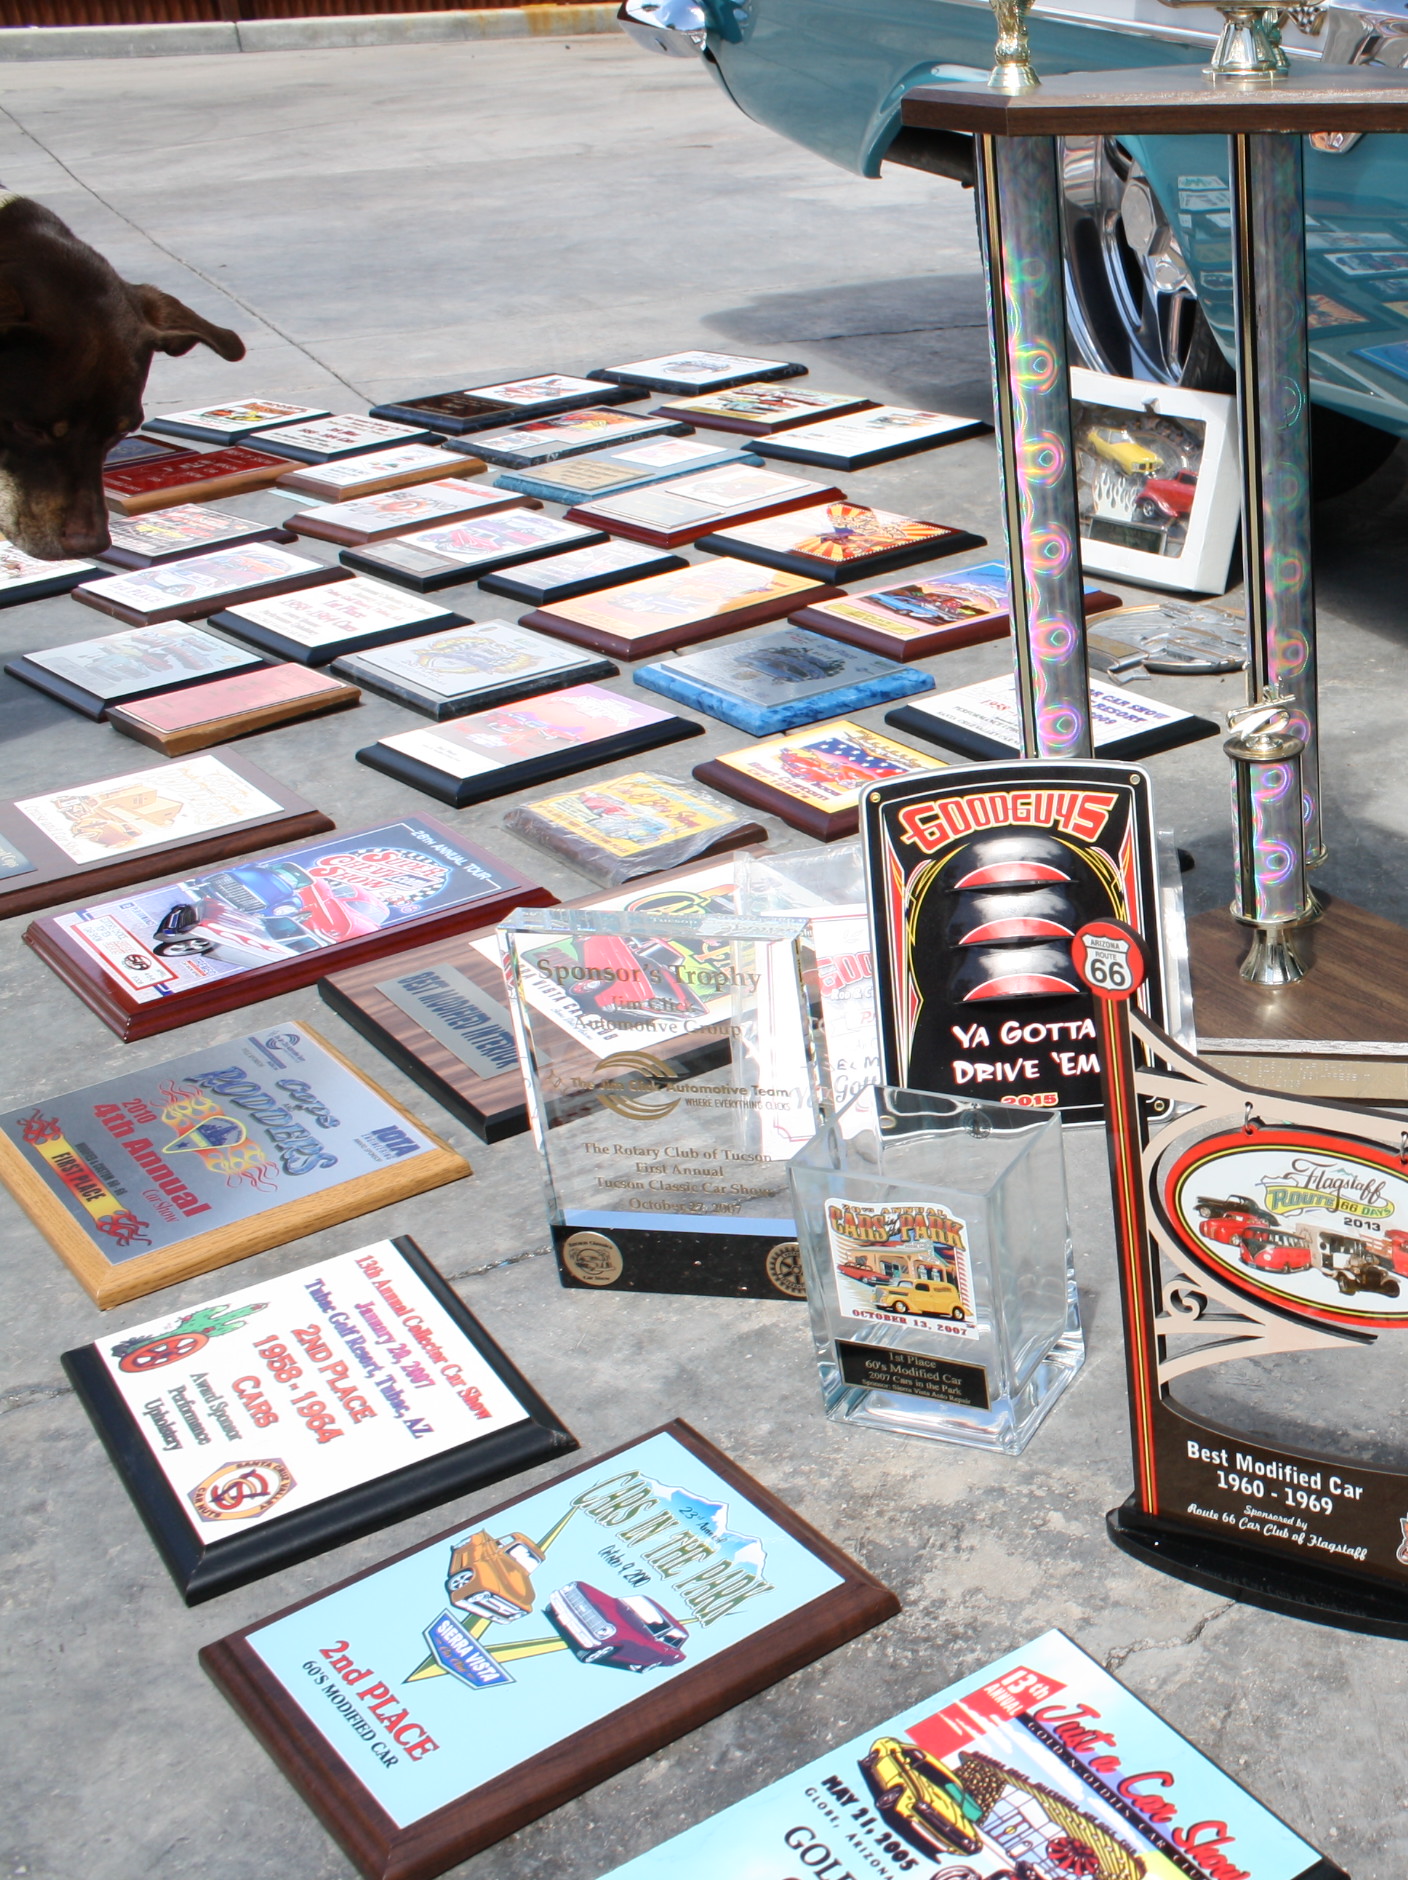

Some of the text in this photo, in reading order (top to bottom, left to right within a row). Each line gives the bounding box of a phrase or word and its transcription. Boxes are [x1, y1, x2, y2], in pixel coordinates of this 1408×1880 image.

[1092, 702, 1148, 723] RESORT
[1127, 703, 1171, 720] SHOW
[898, 789, 1119, 855] GOODGUYS
[1089, 938, 1121, 951] ARIZONA
[1094, 951, 1118, 961] ROUTE
[397, 970, 450, 995] BEST
[536, 958, 663, 987] Sponsor's
[672, 964, 762, 993] Trophy
[1090, 959, 1127, 988] 66
[420, 988, 492, 1031] MODIFIED
[574, 1016, 678, 1034] Automotive
[683, 1019, 742, 1037] Group
[951, 1018, 1097, 1051] YA GOTTA
[570, 1077, 595, 1092] The
[666, 1082, 749, 1096] Automotive
[752, 1085, 790, 1098] Team
[952, 1058, 1041, 1085] DRIVE
[121, 1097, 158, 1125] 2010
[276, 1078, 341, 1130] Cops
[684, 1098, 763, 1111] WHERE EVERYTHING
[1000, 1092, 1059, 1108] 2015
[183, 1066, 338, 1176] RODDERS
[371, 1125, 421, 1158] IOTA
[583, 1142, 772, 1163] The Rotary Club of Tucson
[50, 1151, 107, 1203] FIRST PLACE
[93, 1103, 213, 1218] 4th Annual
[635, 1162, 725, 1178] First Annual
[595, 1176, 645, 1190] Tucson
[648, 1179, 699, 1194] Classic
[701, 1182, 727, 1195] Car
[1290, 1158, 1388, 1208] Flagstaff
[141, 1188, 180, 1223] Car Show
[628, 1197, 685, 1213] October
[881, 1206, 948, 1218] ANNUAL
[1270, 1186, 1393, 1218] ROUTE 66 DAYS
[827, 1205, 967, 1250] CARS PARK
[1342, 1216, 1382, 1232] 2013
[354, 1255, 493, 1420] 13th Annual Collector Car Show
[852, 1308, 968, 1337] OCTOBER 13, 2007
[290, 1323, 333, 1363] 2ND
[304, 1277, 435, 1439] Tubac Golf Resort, Tubac, AZ
[354, 1301, 436, 1389] January 2007
[889, 1351, 936, 1369] 1st Place
[252, 1334, 345, 1445] 1958 1964
[865, 1359, 963, 1386] 60's Modified Car
[868, 1370, 963, 1396] 2007 Cars Park
[142, 1397, 184, 1451] Upholstery
[167, 1384, 212, 1446] Performance
[190, 1372, 243, 1441] Award Sponsor
[1186, 1440, 1364, 1501] Best Modified Car
[1217, 1470, 1335, 1516] 1960 1969
[1186, 1502, 1368, 1562] Route 66 Car Club of Flagstaff
[1242, 1503, 1310, 1532] Sponsored by
[570, 1469, 776, 1629] CARS IN THE PARK
[436, 1619, 501, 1683] SIERRA VISTA
[319, 1639, 441, 1762] 2nd PLACE
[983, 1682, 1023, 1717] ANNUAL
[1000, 1669, 1050, 1701] 13th
[302, 1660, 399, 1770] 60'S MODIFIED CAR
[1034, 1703, 1118, 1754] Just
[1089, 1755, 1121, 1774] a
[1117, 1770, 1178, 1824] Car
[804, 1786, 841, 1829] GLOBE,
[820, 1774, 920, 1872] MAY 21, 2005
